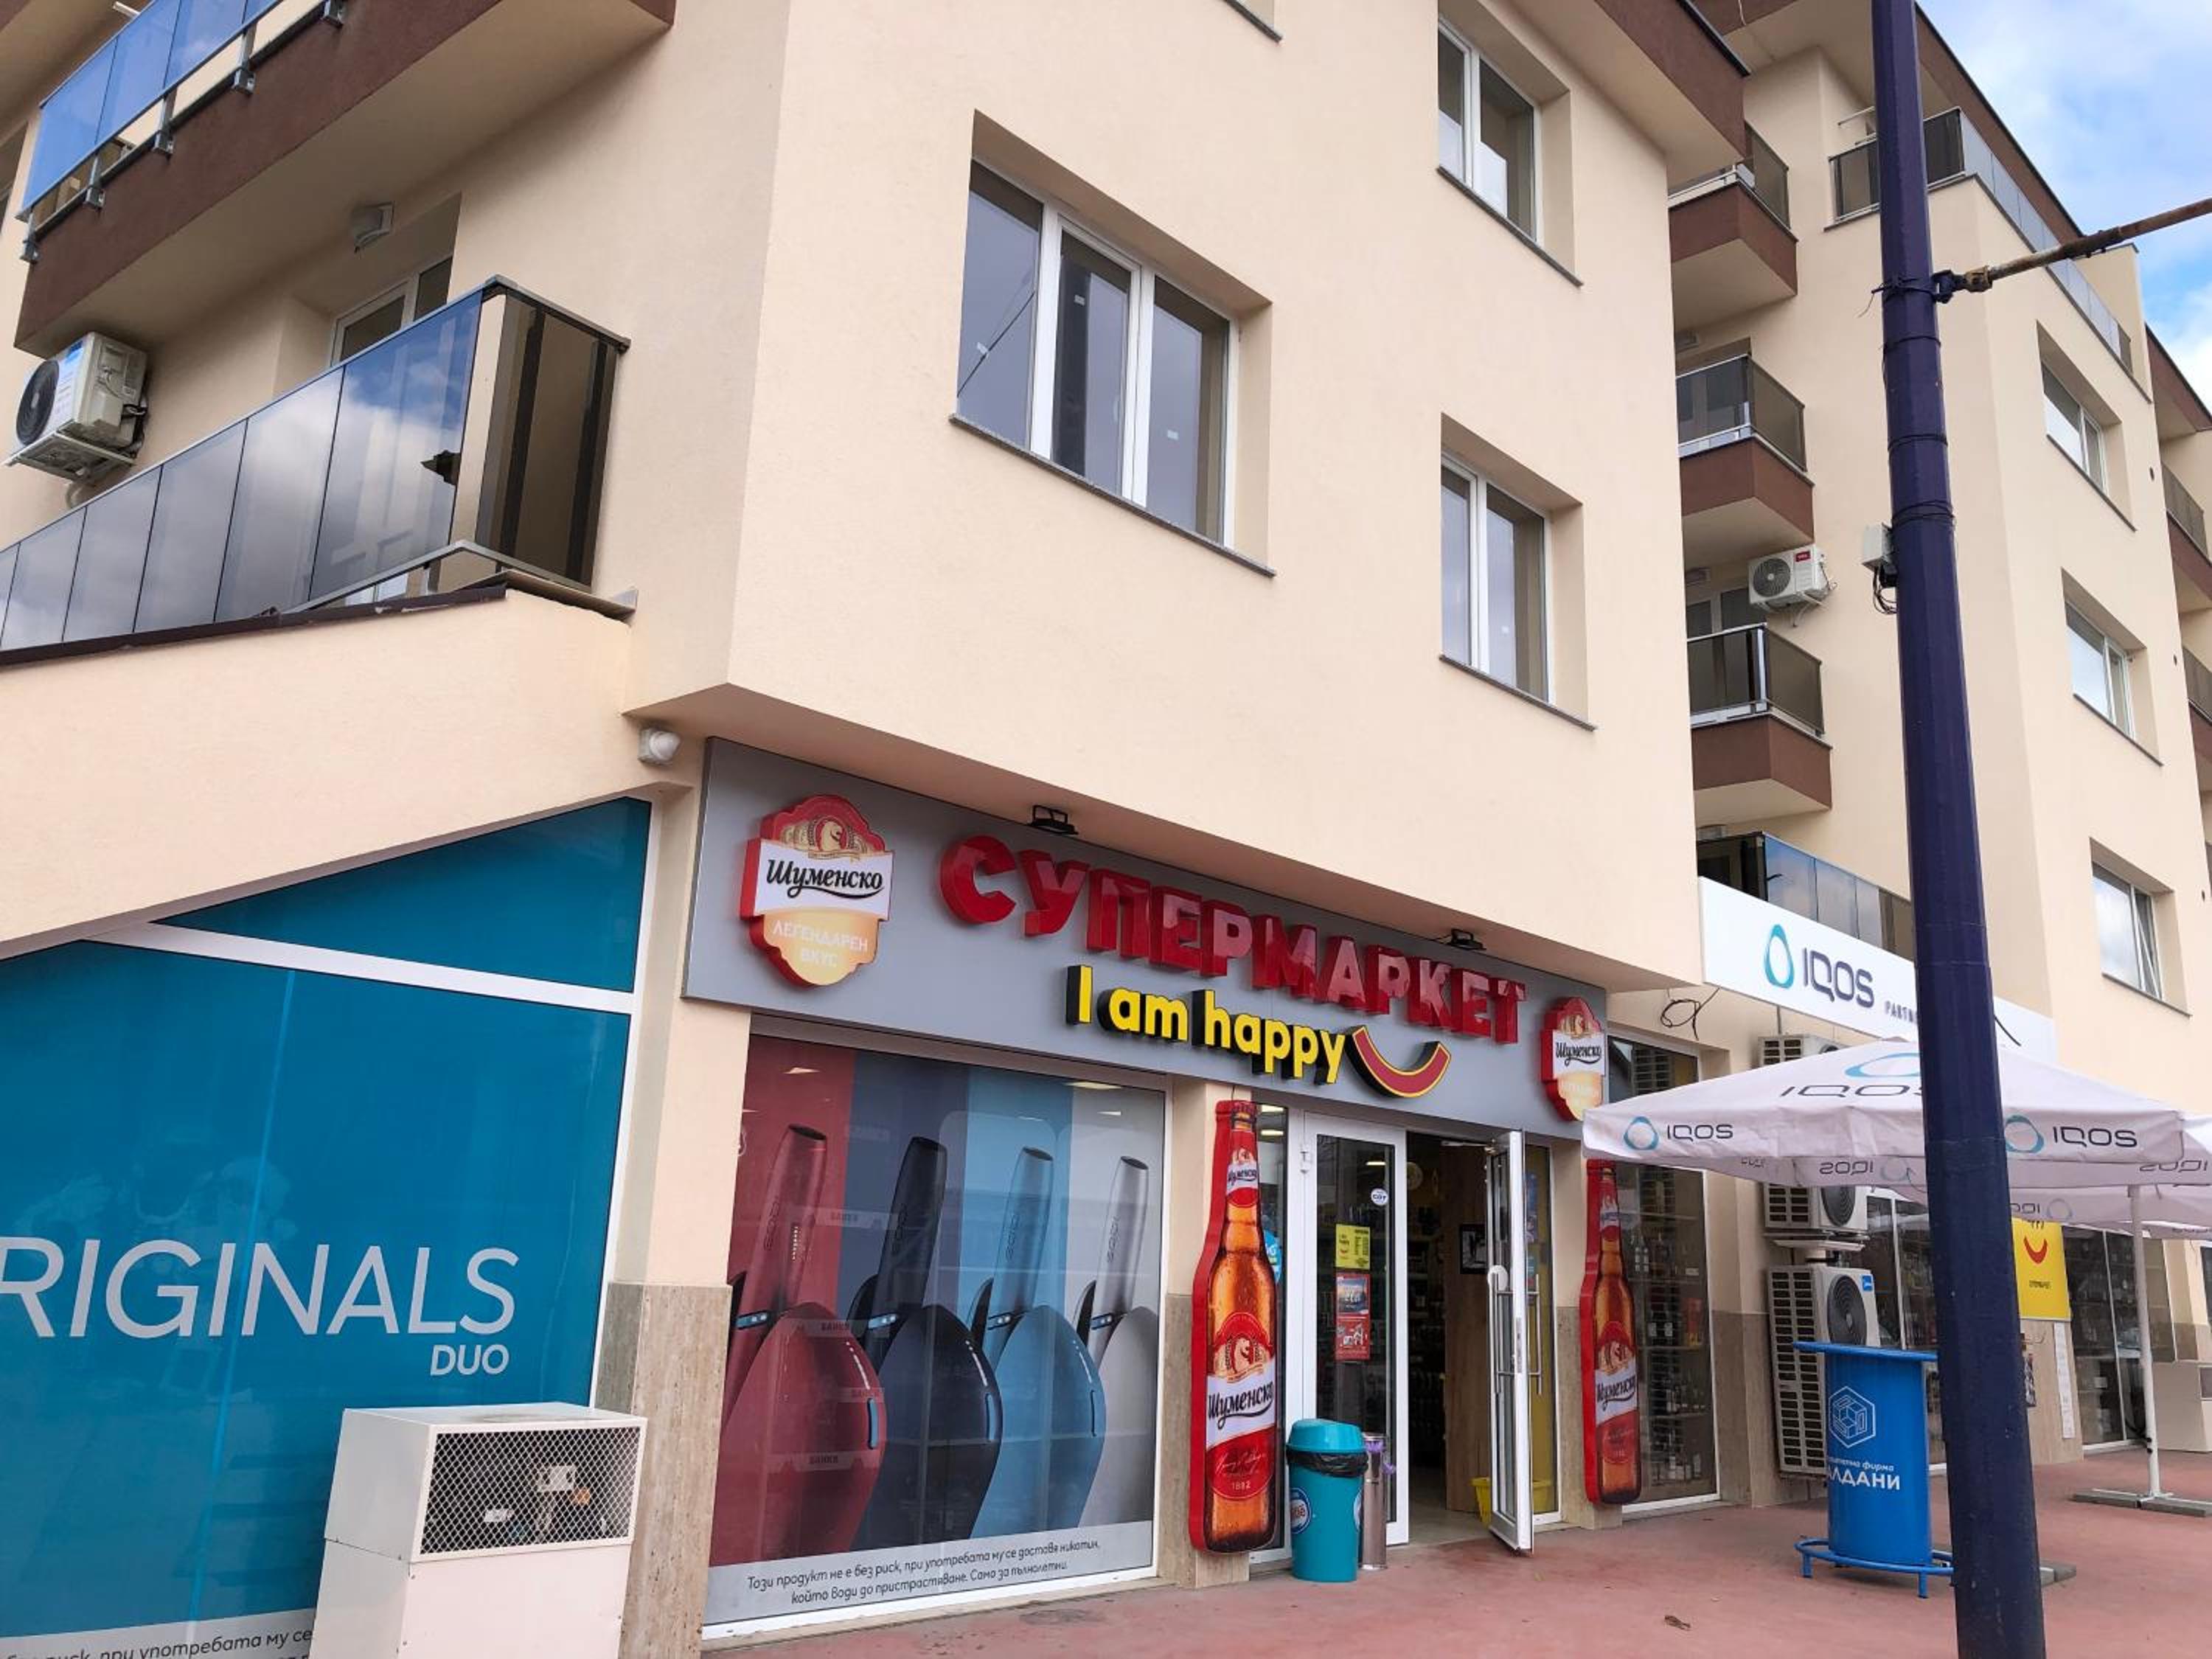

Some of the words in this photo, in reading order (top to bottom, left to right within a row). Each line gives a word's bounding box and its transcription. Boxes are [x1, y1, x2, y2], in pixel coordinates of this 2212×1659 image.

[767, 860, 884, 900] Шуменско
[773, 919, 868, 952] ЛЕГЕНДАРЕН
[940, 834, 1527, 1044] СУПЕРМАРКЕТ
[1803, 947, 1874, 1008] IQOS
[1066, 964, 1093, 1025] I
[1099, 987, 1189, 1041] am
[1192, 989, 1345, 1085] happy
[1555, 1042, 1602, 1066] Шуменско
[1667, 1124, 1733, 1141] IQOS
[2053, 1127, 2138, 1147] IQOS
[430, 1344, 509, 1377] DUO
[1208, 1381, 1273, 1430] Шуменско
[748, 1576, 773, 1593] Този
[776, 1571, 828, 1589] продукт
[830, 1570, 843, 1581] не
[846, 1569, 852, 1578] е
[854, 1564, 874, 1580] без
[875, 1560, 902, 1577] риск,
[905, 1561, 924, 1575] при
[925, 1550, 990, 1572] употребата
[992, 1551, 1006, 1564] му
[1005, 1548, 1017, 1558] се
[1018, 1541, 1059, 1561] доставя
[791, 1590, 828, 1604] който
[831, 1586, 858, 1601] води
[859, 1587, 873, 1599] до
[970, 1567, 995, 1581] Само
[998, 1568, 1010, 1579] за
[139, 1635, 261, 1659] употребата
[266, 1630, 289, 1649] му
[293, 1630, 313, 1641] се
